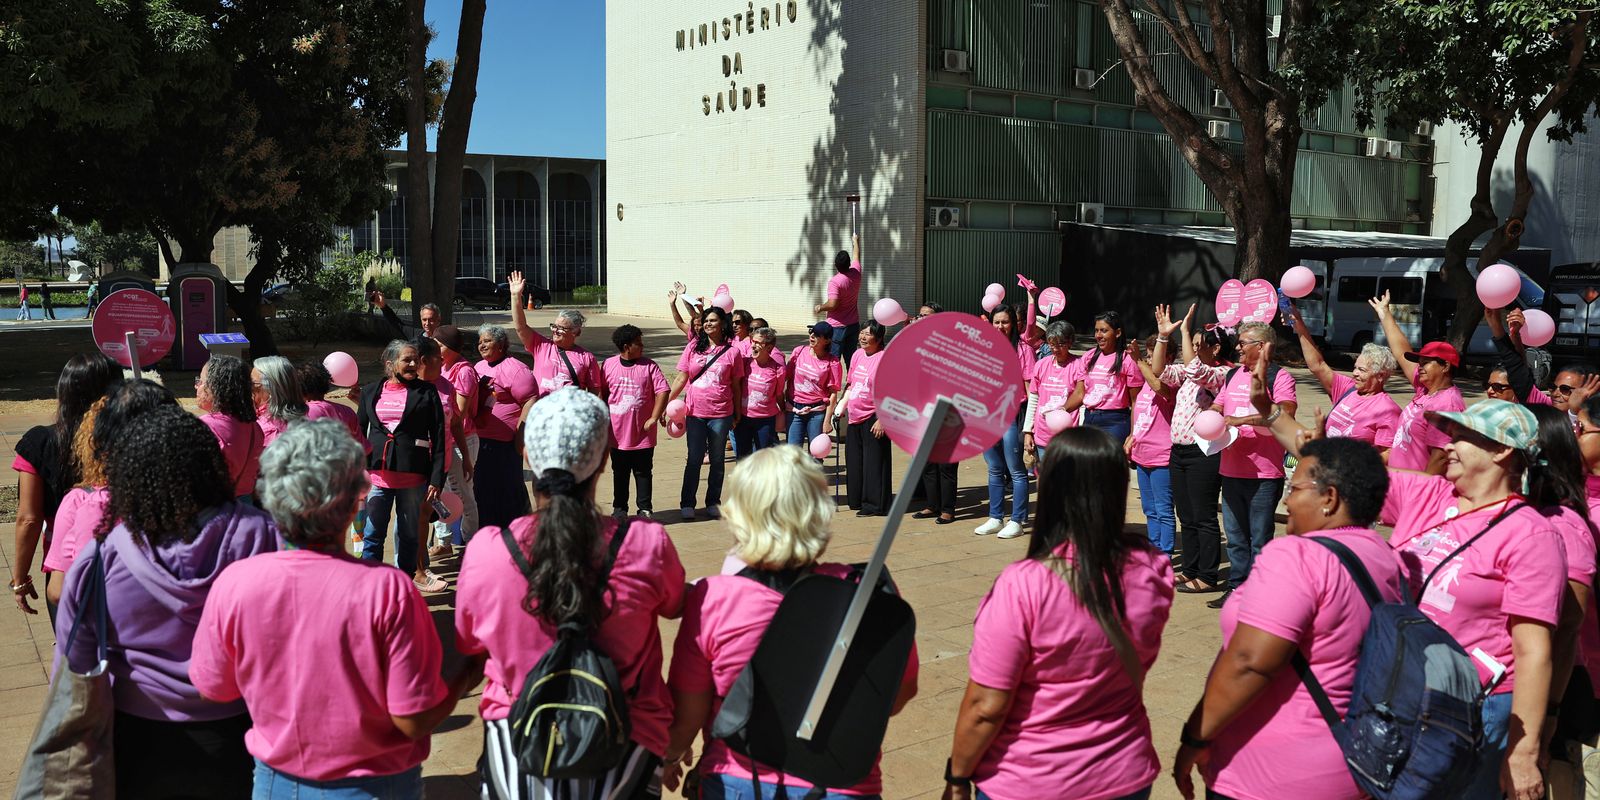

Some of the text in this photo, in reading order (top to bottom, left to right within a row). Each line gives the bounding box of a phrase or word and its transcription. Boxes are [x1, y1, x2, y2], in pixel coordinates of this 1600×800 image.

[676, 0, 797, 52] MINISTÉRIO
[722, 52, 743, 78] DA
[702, 80, 766, 116] SAÚDE
